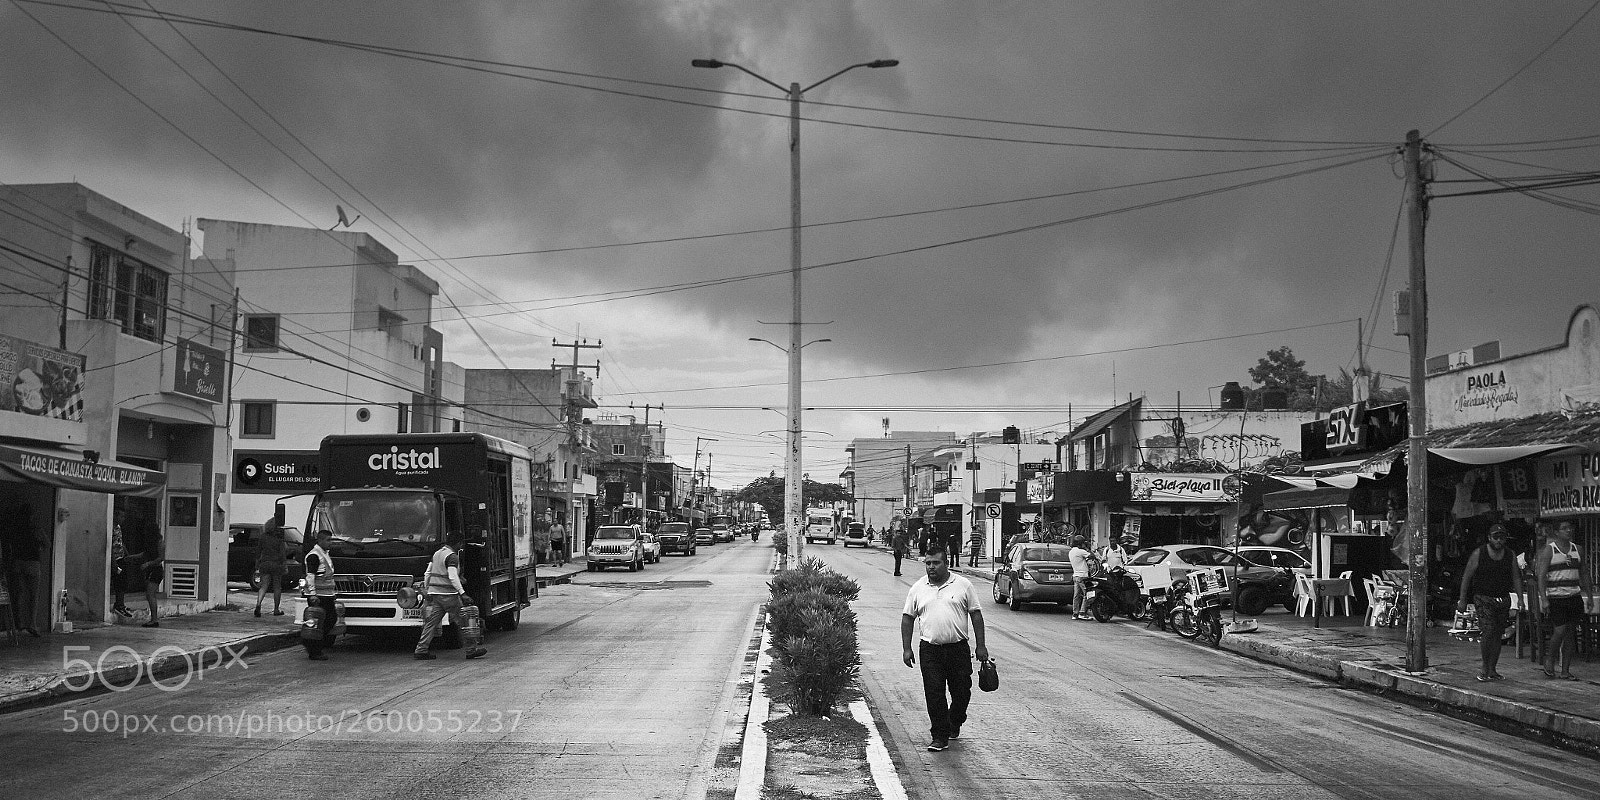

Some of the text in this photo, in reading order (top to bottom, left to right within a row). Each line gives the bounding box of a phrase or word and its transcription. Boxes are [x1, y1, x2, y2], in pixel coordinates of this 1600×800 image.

[1468, 370, 1506, 390] PAOLA
[20, 454, 47, 473] TACOS
[48, 459, 59, 475] DE
[60, 461, 93, 479] CANASTA
[368, 445, 440, 470] cristal
[264, 463, 295, 474] Sushi
[1553, 461, 1569, 479] MI
[1213, 479, 1220, 490] II
